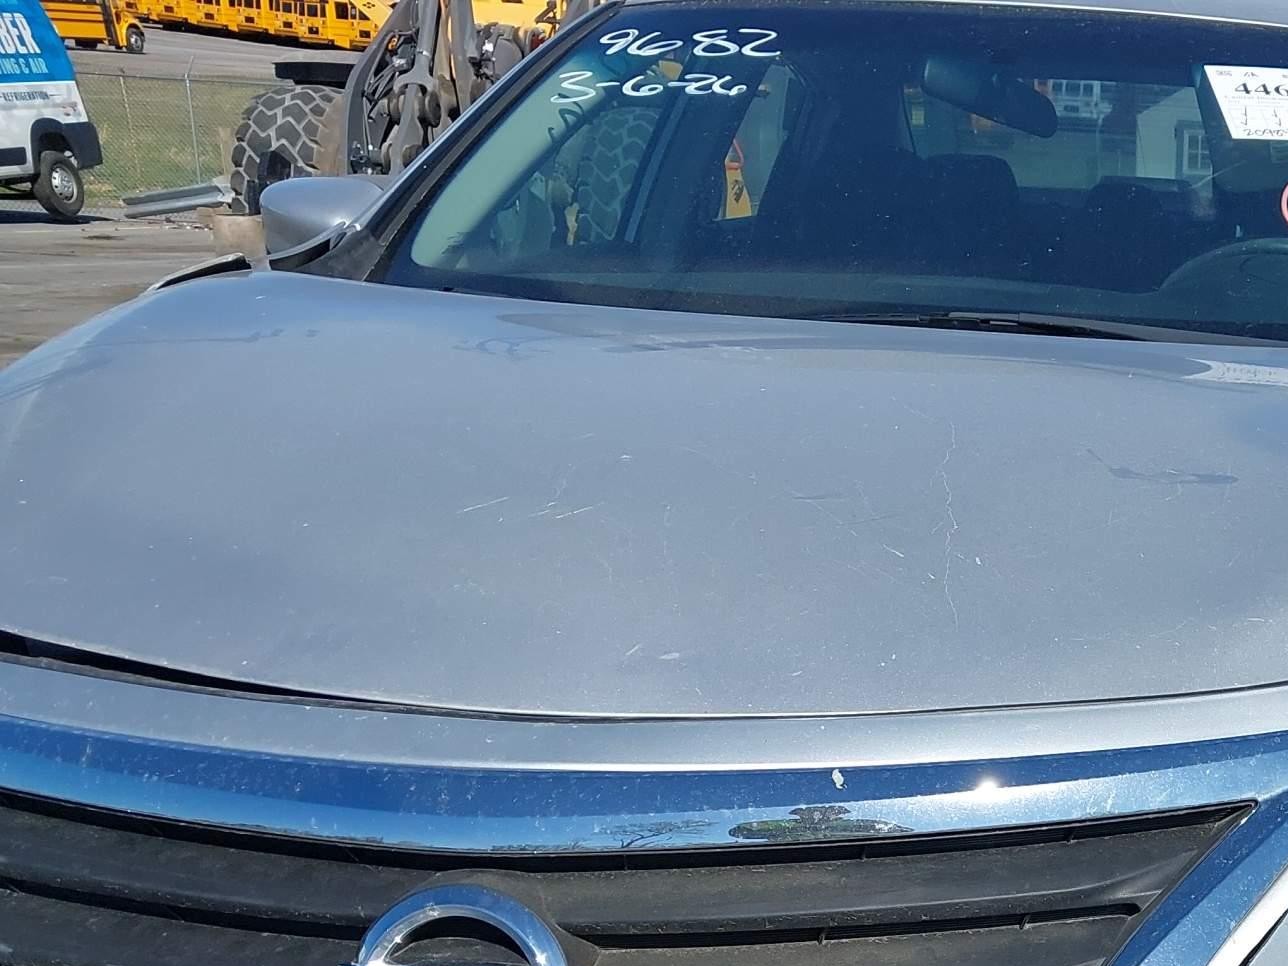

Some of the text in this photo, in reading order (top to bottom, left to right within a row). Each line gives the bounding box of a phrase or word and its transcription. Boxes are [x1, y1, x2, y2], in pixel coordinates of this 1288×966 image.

[0, 12, 41, 54] BER
[0, 57, 20, 75] ING
[29, 57, 48, 74] AIR
[2, 90, 50, 102] REFRIGERATION
